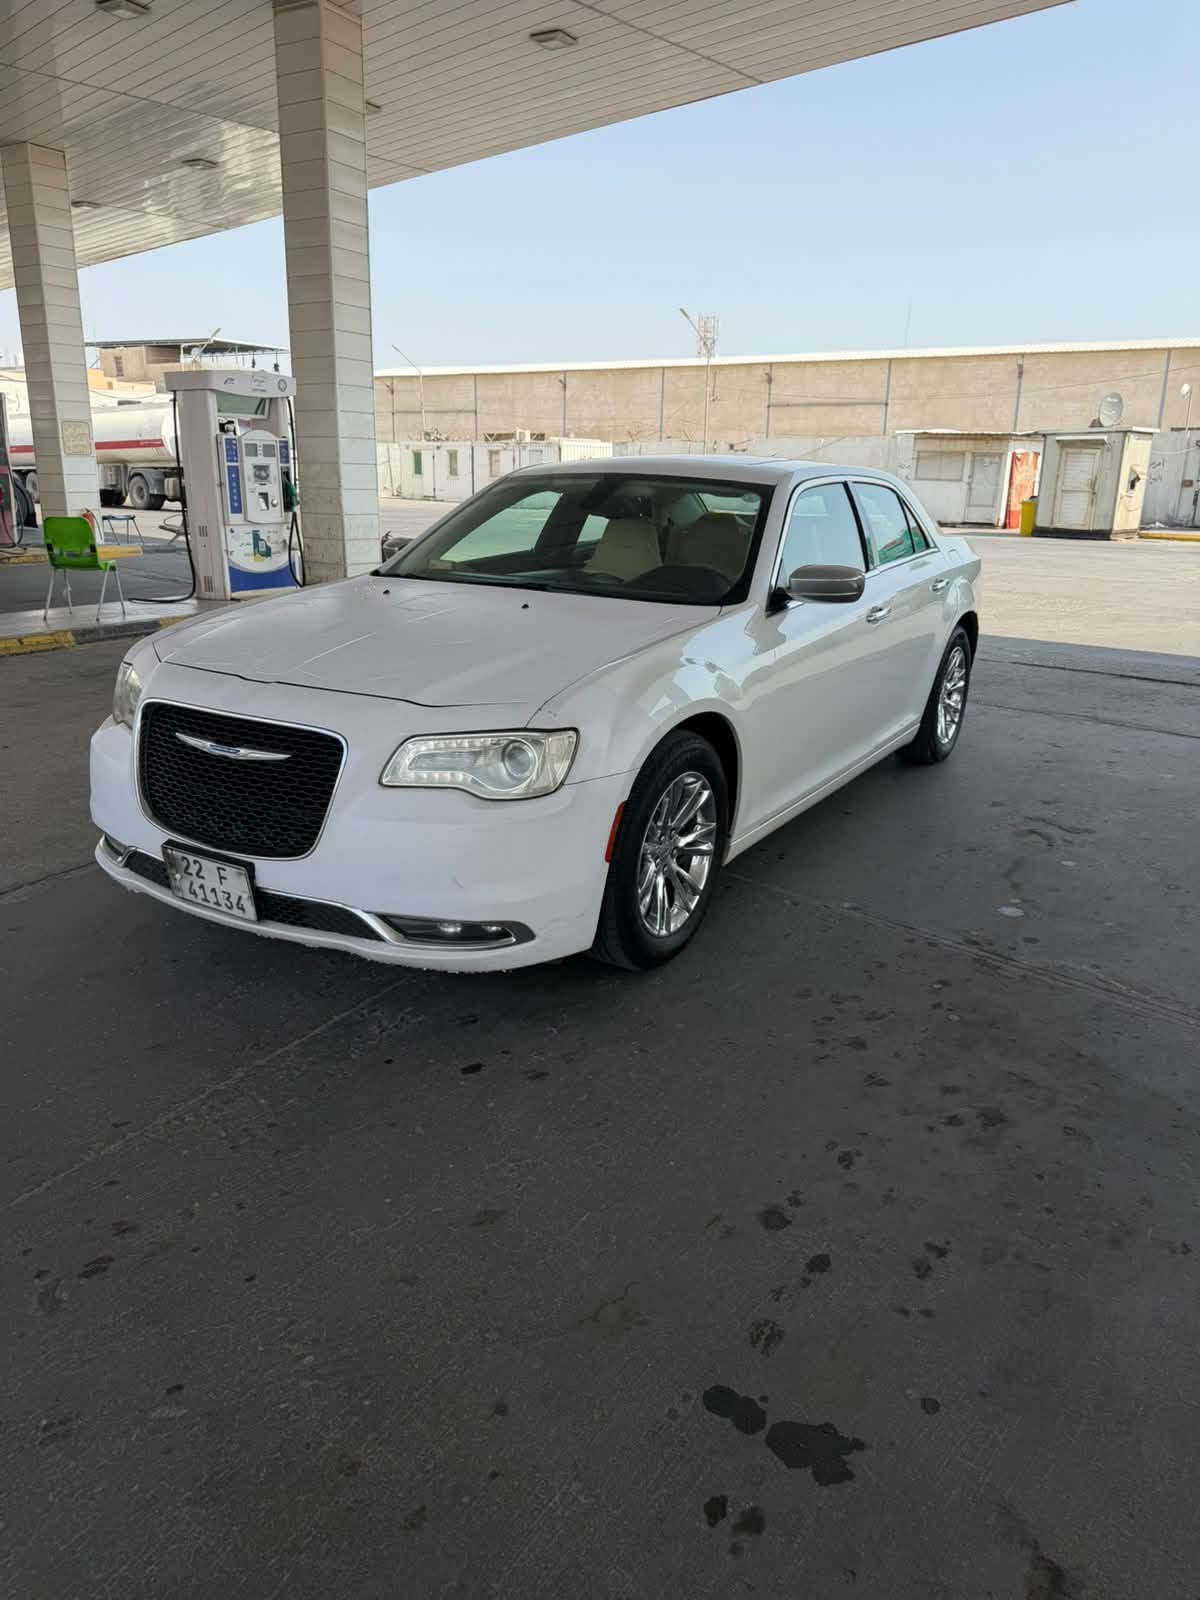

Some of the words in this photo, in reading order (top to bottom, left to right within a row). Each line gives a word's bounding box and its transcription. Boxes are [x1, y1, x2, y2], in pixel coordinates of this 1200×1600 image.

[181, 856, 205, 880] 22
[216, 866, 228, 886] F
[188, 881, 246, 914] 41134
